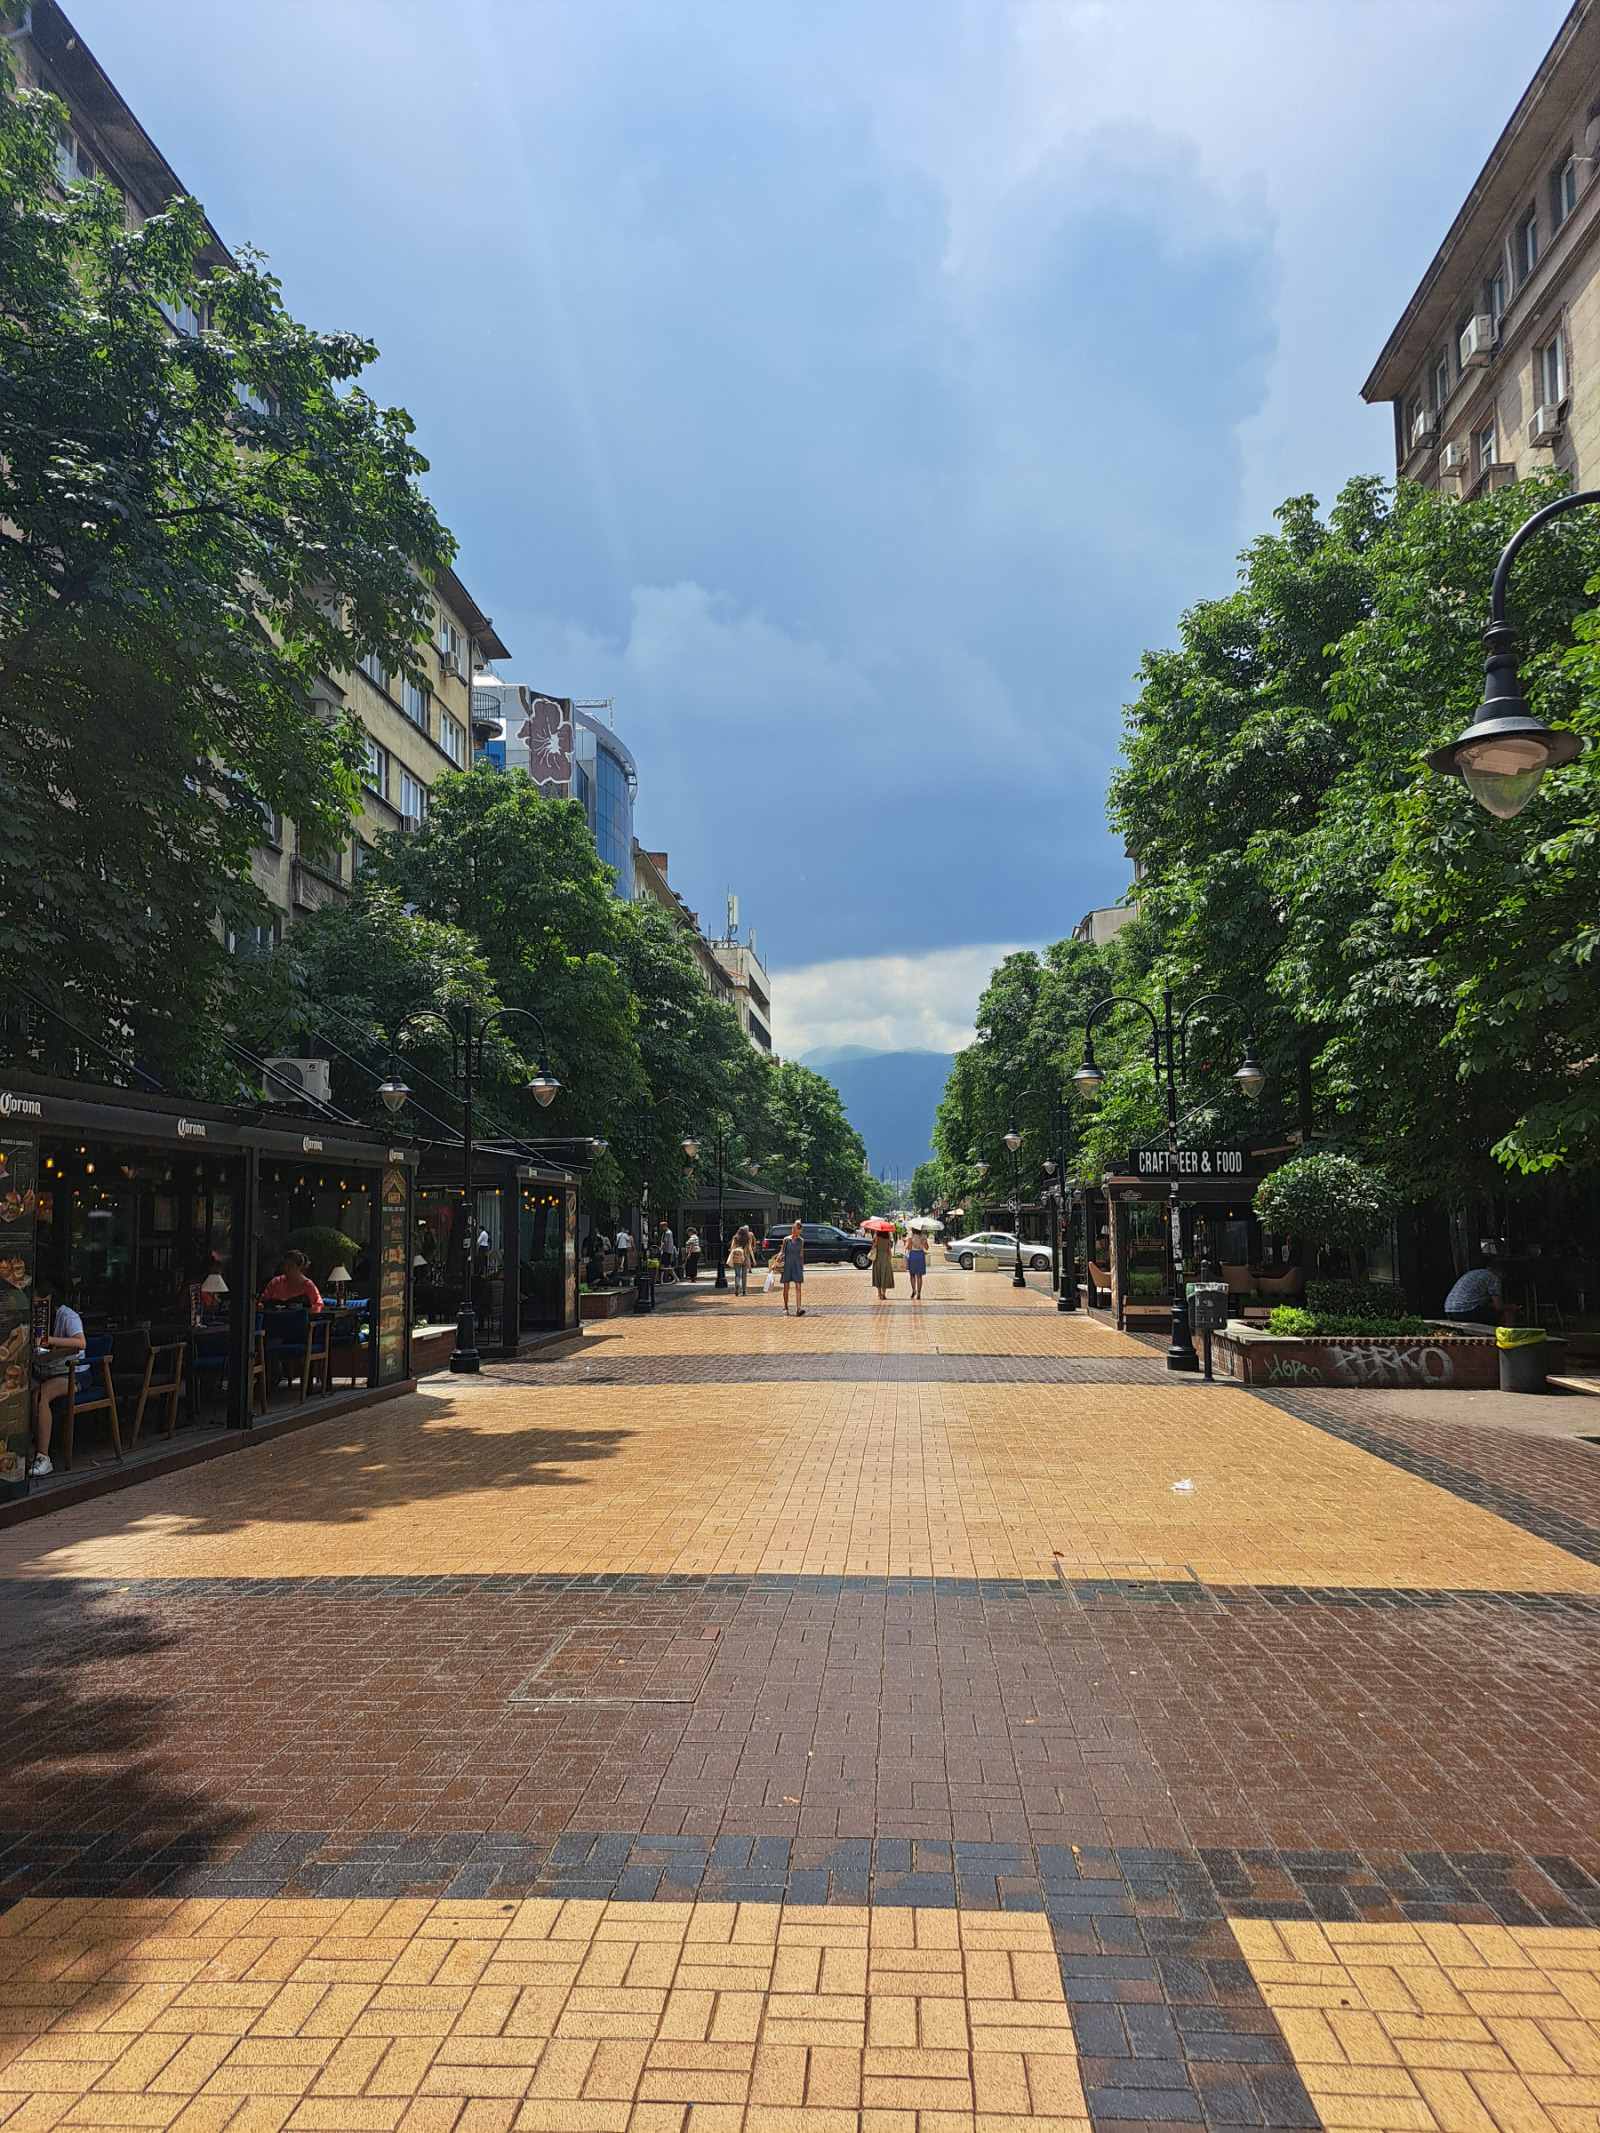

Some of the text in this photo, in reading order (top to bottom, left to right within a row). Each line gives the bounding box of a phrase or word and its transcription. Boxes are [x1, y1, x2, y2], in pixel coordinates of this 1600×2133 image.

[0, 1092, 42, 1118] Corona
[177, 1118, 207, 1139] Corona
[1138, 1151, 1171, 1173] CRAFT
[1201, 1150, 1212, 1173] &
[1216, 1151, 1243, 1173] FOOD
